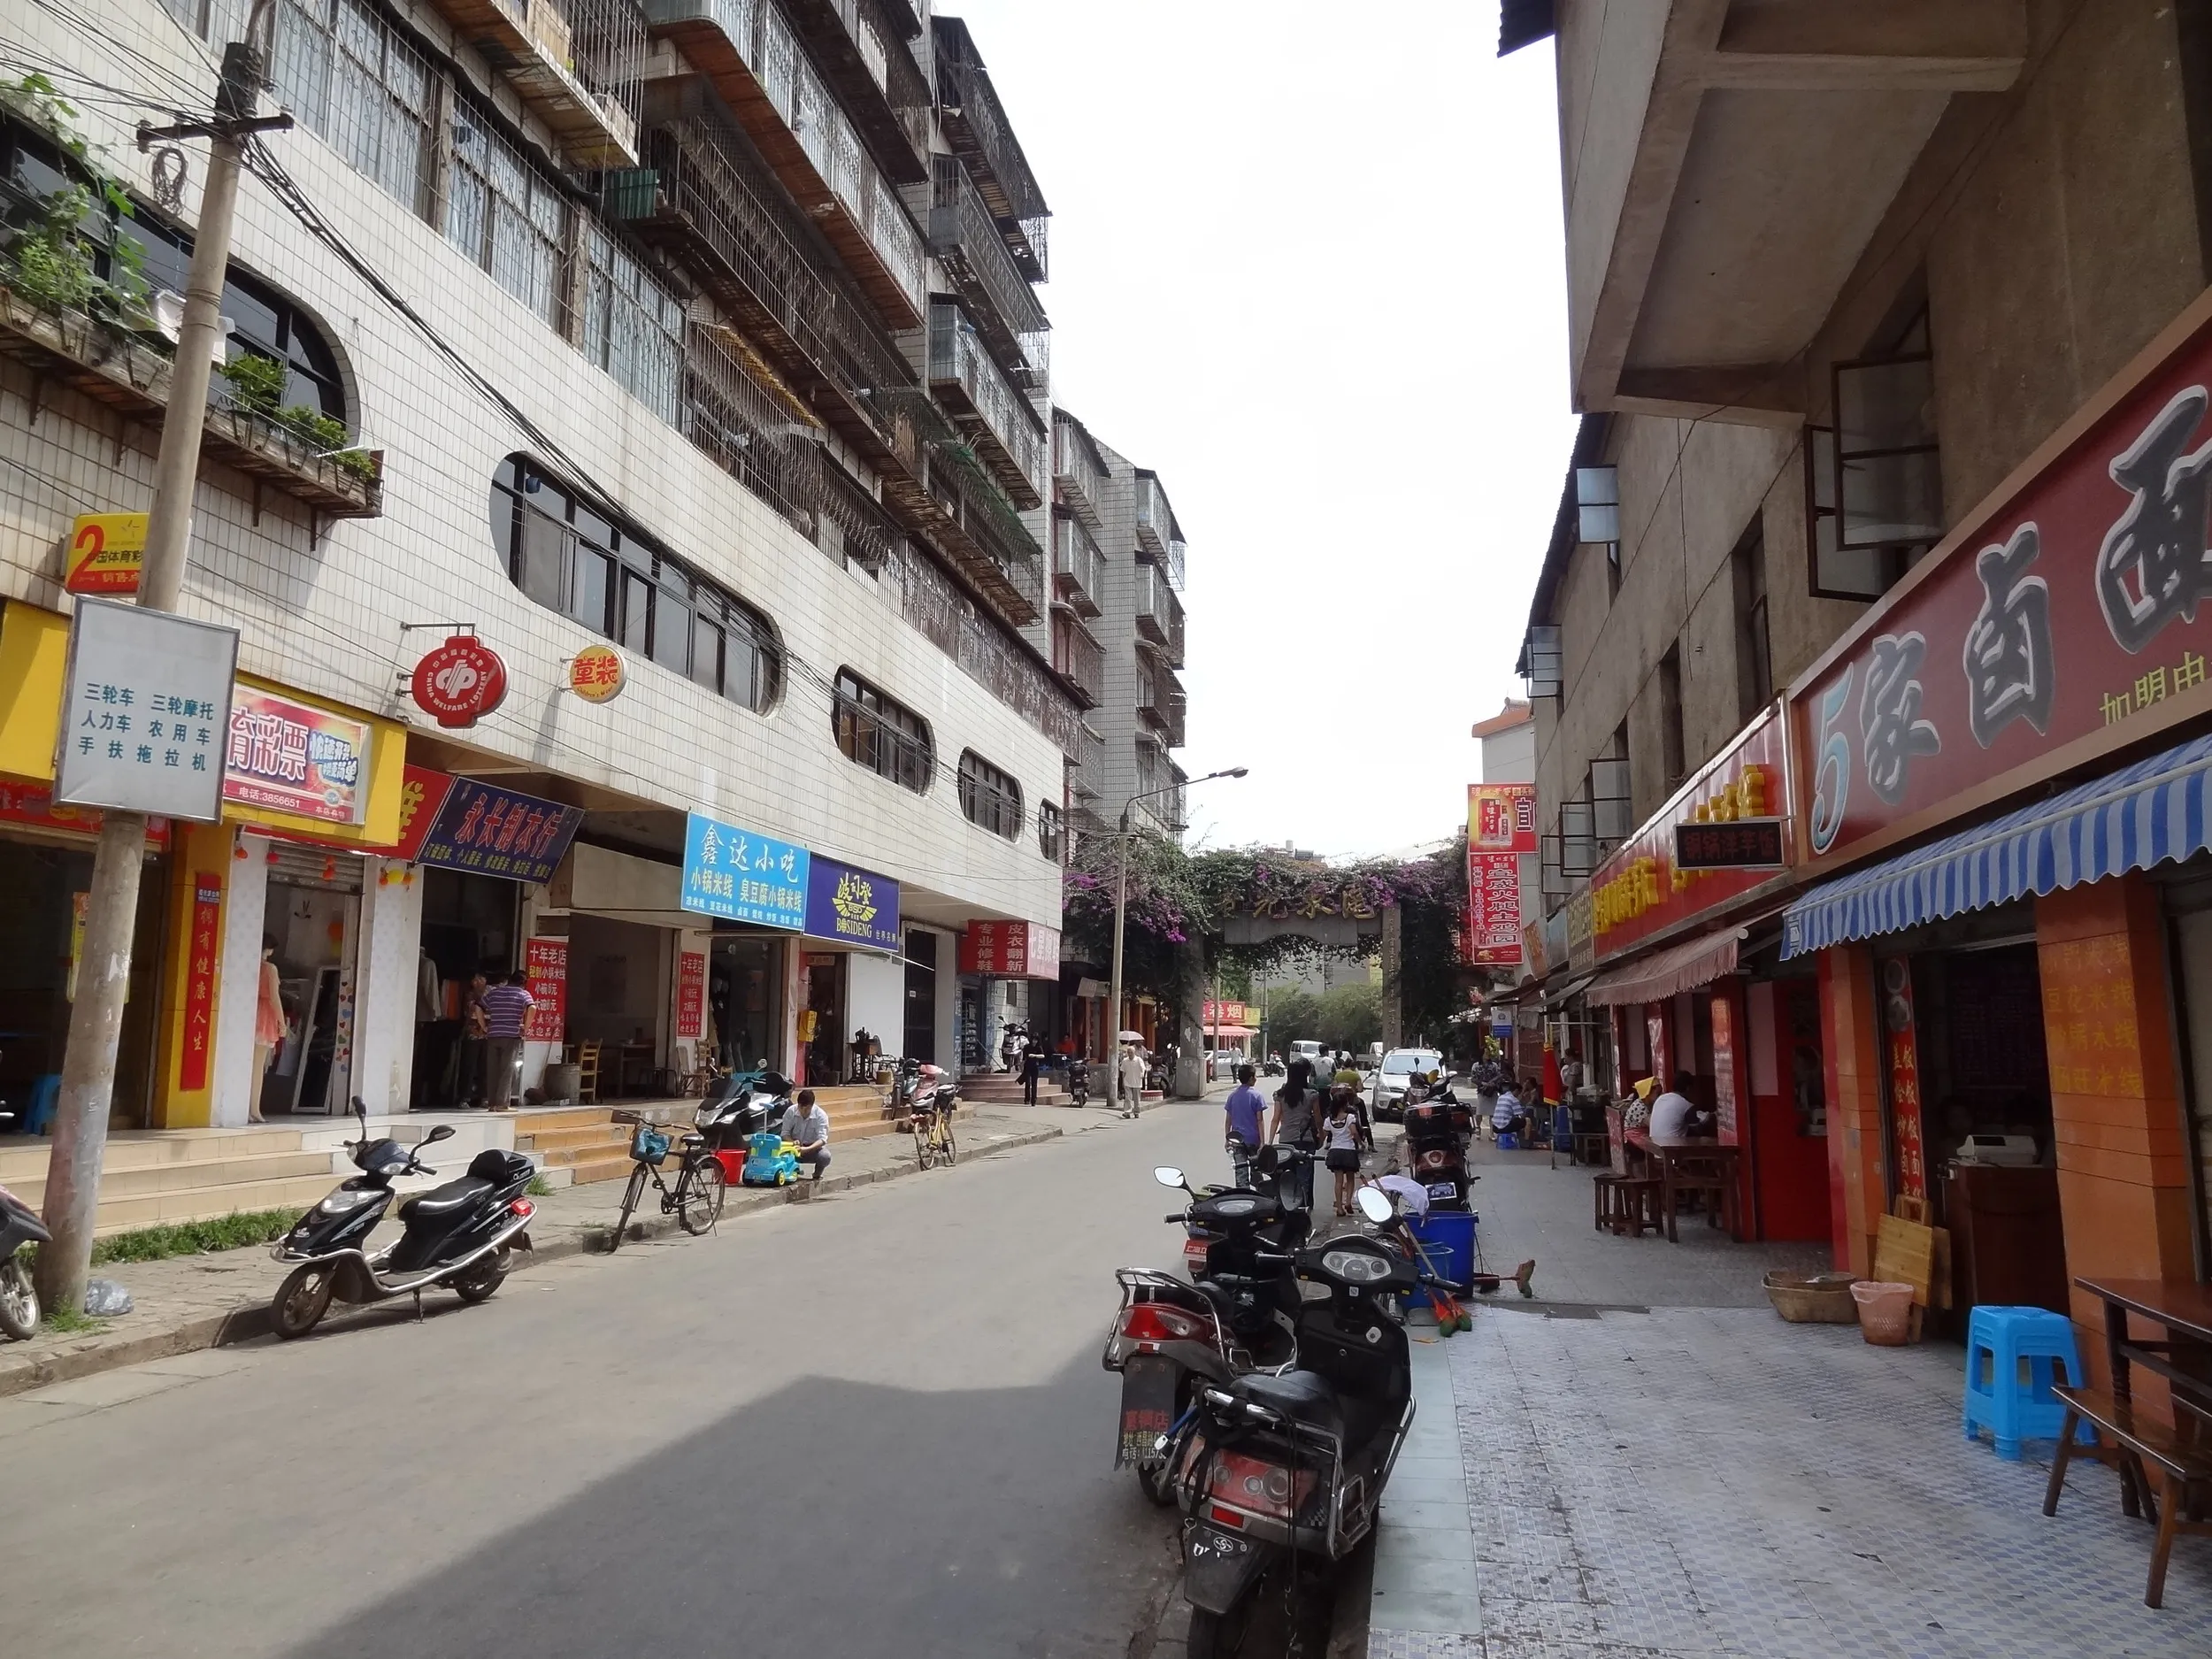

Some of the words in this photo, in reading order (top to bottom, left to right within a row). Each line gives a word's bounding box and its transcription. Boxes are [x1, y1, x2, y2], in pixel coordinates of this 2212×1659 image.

[572, 655, 618, 686] 童装
[84, 682, 134, 706] 三轮车
[150, 694, 214, 722] 三轮摩托
[433, 697, 469, 711] WELFARE
[81, 709, 132, 733] 人力车
[149, 720, 211, 746] 农用车
[78, 736, 207, 772] 手扶拖拉机
[701, 825, 800, 883] 鑫达小吃
[690, 866, 733, 900] 小锅米线
[740, 878, 803, 914] 臭豆腐小锅米线
[837, 872, 872, 905] 波司登
[836, 917, 872, 939] BOSIDENG
[530, 944, 567, 965] 十年老店
[977, 923, 995, 972] 专业修鞋
[1006, 923, 1025, 972] 皮衣翻新
